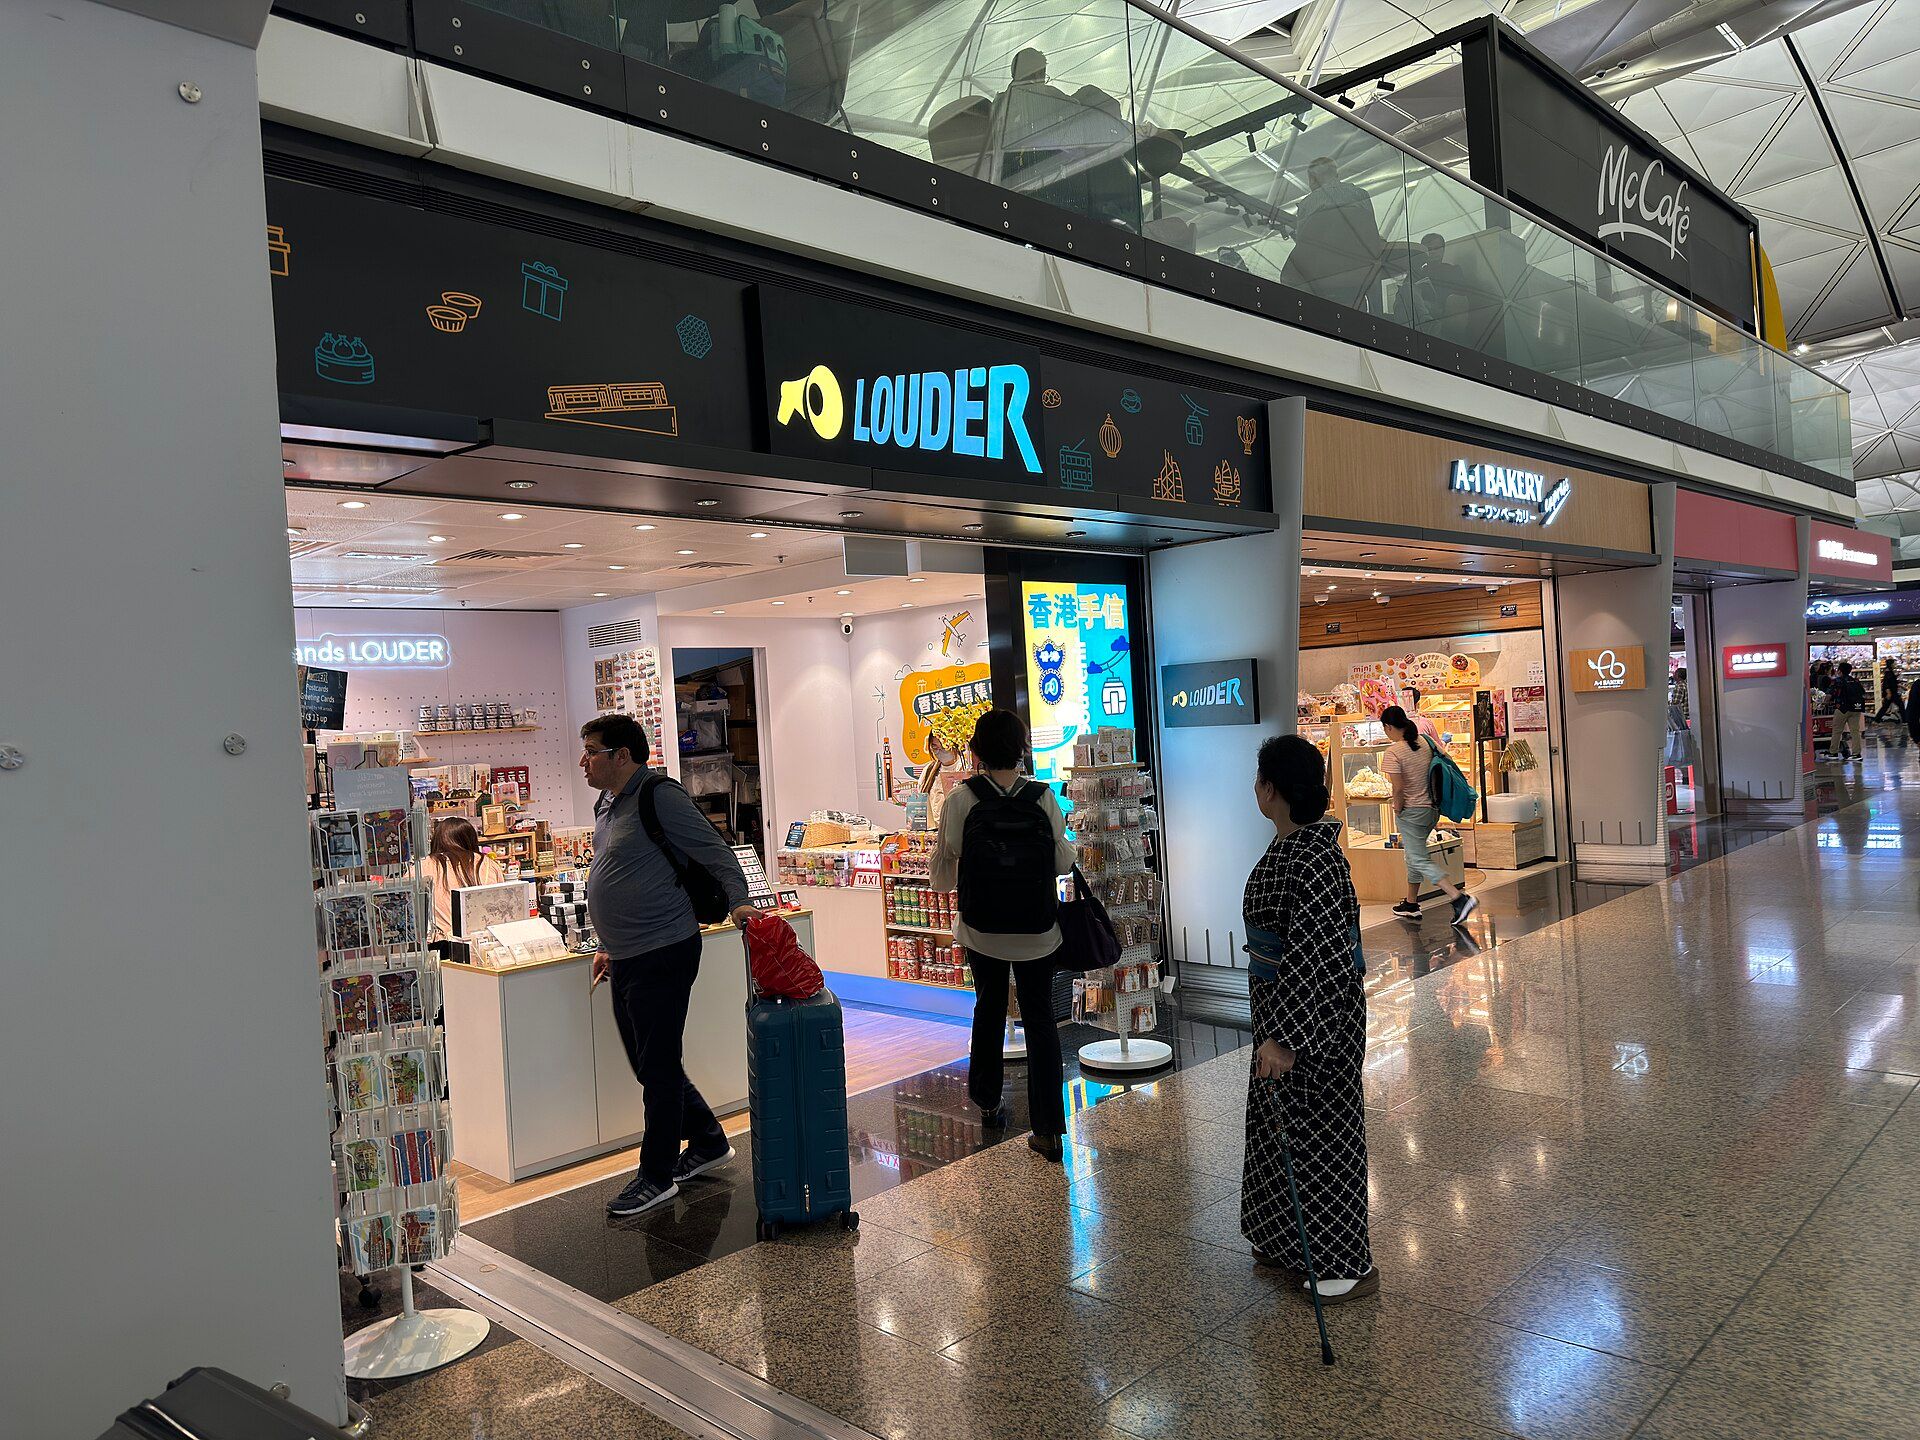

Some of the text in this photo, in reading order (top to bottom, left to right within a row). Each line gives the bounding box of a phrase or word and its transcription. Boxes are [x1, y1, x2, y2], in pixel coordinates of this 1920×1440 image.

[1597, 144, 1691, 260] McCafé
[853, 363, 1043, 473] LOUDER
[1455, 459, 1481, 493] A-1
[1485, 464, 1544, 502] BAKERY
[1468, 503, 1537, 523] エーワンベーカリー
[1028, 593, 1125, 629] 香港手信
[350, 641, 443, 661] LOUDER
[1353, 665, 1372, 673] mini
[917, 682, 991, 714] 香港手信集
[1189, 677, 1244, 707] LOUDER
[857, 875, 878, 885] TAXI
